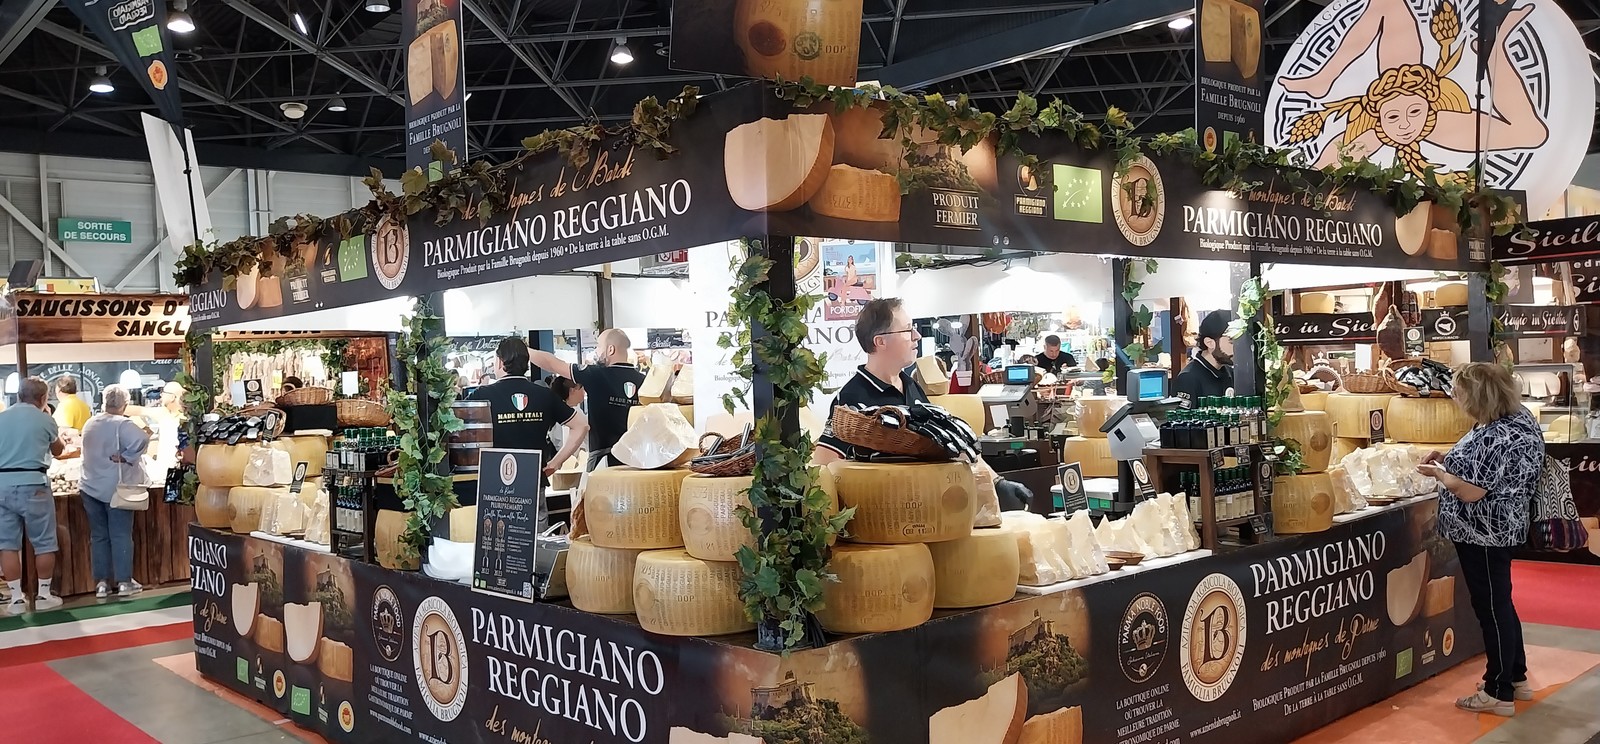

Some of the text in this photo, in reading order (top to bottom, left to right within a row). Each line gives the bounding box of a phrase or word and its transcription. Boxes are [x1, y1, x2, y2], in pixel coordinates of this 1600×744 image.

[1201, 88, 1261, 113] FAMILLE BRUGNOLI
[1217, 111, 1234, 122] DEPUIS
[409, 117, 462, 146] FAMILLE BRUGNOLI
[549, 166, 566, 199] de
[932, 192, 979, 209] PRODUIT
[1016, 197, 1046, 207] PARMIGIANO
[1019, 206, 1043, 215] REGGIANO
[1248, 177, 1295, 223] montagnes
[77, 221, 113, 232] SORTIE
[423, 178, 692, 268] PARMIGIANO REGGIANO
[936, 209, 978, 226] FERMIER
[1183, 205, 1383, 248] PARMIGIANO REGGIANO
[64, 231, 127, 242] DE SECOURS
[1199, 238, 1224, 252] Biologique
[1303, 245, 1313, 254] 1960
[1316, 246, 1322, 255] De
[436, 224, 670, 281] Biologique Produit par la Famille Brugnoli depuis 1960 De la terre à la table sans O.G.M.
[17, 299, 153, 317] SAUCISSONS
[1531, 310, 1567, 330] in Sicilia
[115, 320, 186, 337] SANGL
[1298, 322, 1321, 334] in
[524, 411, 543, 419] ITALY
[638, 506, 655, 515] DOP
[905, 501, 923, 510] DOP
[1249, 530, 1386, 599] PARMIGIANO
[677, 594, 695, 603] DOP
[1181, 599, 1198, 650] AZIENDA
[1196, 575, 1227, 598] AGRICOLA
[1265, 569, 1375, 635] REGGIANO
[1122, 599, 1165, 645] PARMA NOBLE FOOD
[470, 607, 665, 696] PARMIGIANO
[1197, 605, 1231, 675] B
[1260, 643, 1279, 673] des
[1283, 627, 1329, 678] montagnes
[1334, 617, 1347, 645] de
[425, 624, 454, 686] B
[1181, 643, 1244, 701] FAMIGLIA BRUGNOLI
[1252, 647, 1387, 712] BIOLOGIQUE PRODUIT PAR LA FAMILLE BRUGNOLI DEPUIS 1960
[416, 666, 468, 721] FAMIGLIA BRUGNOLI
[487, 655, 648, 743] REGGIANO
[1116, 683, 1170, 710] LA BOUTIQUE ONLINE
[1283, 672, 1364, 716] DE LA TERRE À LA TABLE SANS O.G.M.
[485, 704, 507, 736] des
[1117, 707, 1173, 738] MEILLEURE TRADITION
[1132, 702, 1156, 719] TROUVER
[1156, 698, 1164, 708] LA
[1156, 718, 1181, 737] DE PARME
